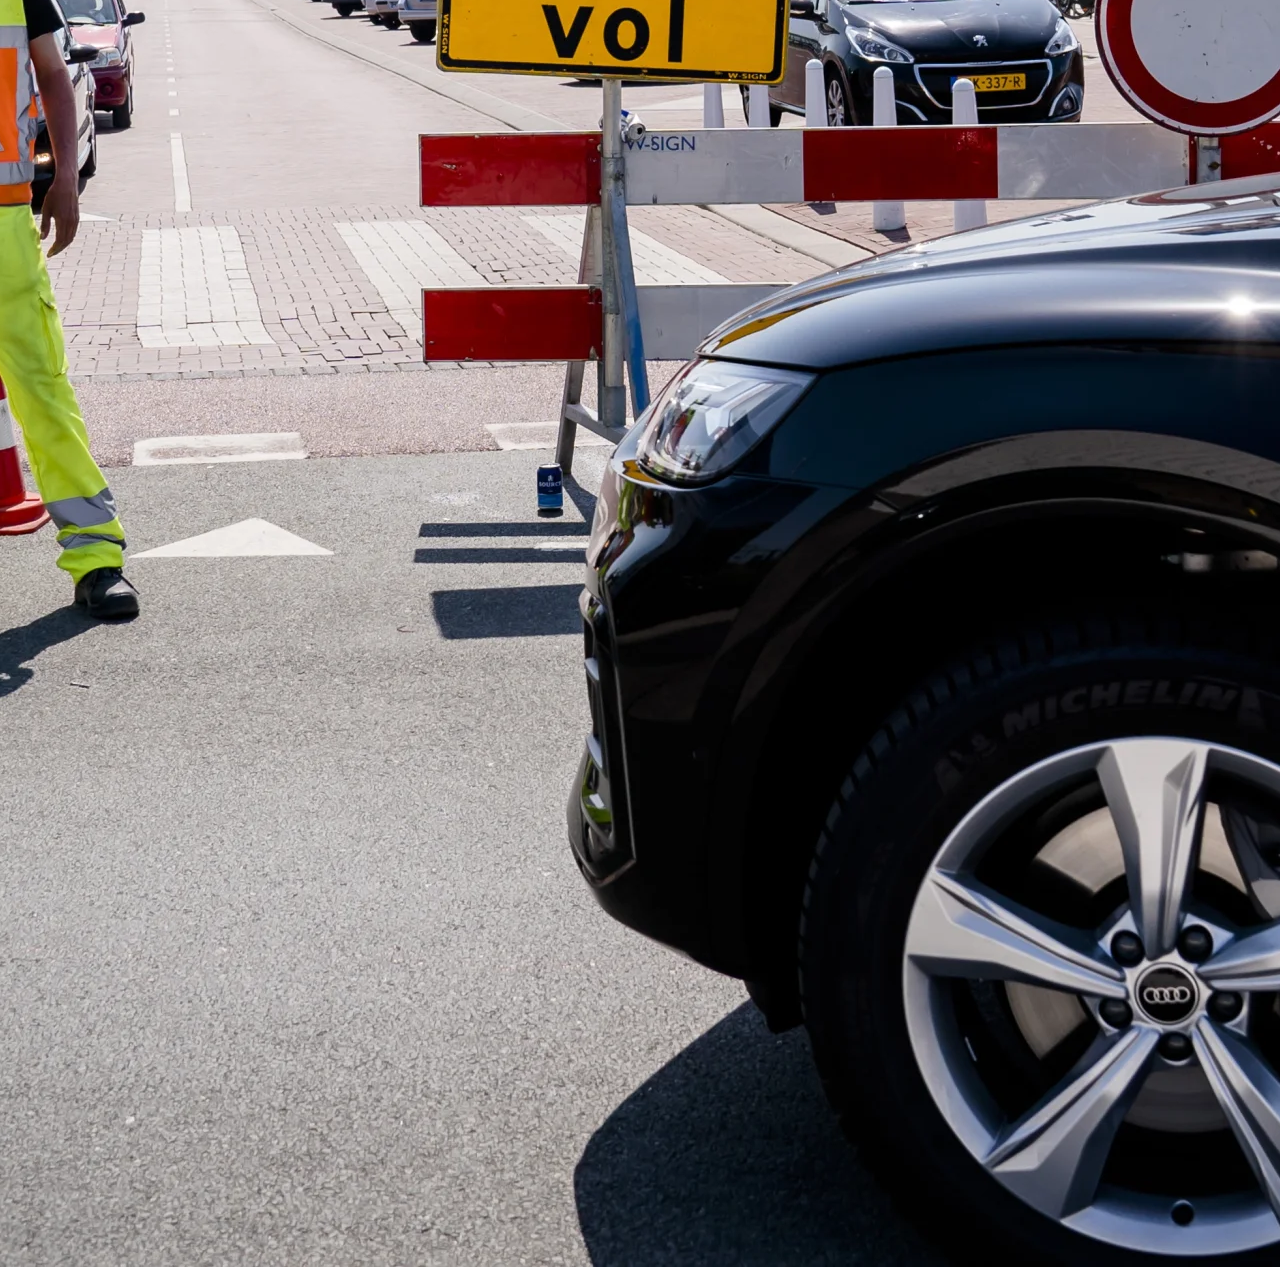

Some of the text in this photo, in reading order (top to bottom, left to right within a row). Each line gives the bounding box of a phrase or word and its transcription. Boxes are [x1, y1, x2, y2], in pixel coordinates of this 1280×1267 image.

[441, 13, 449, 54] W-SIGN
[727, 72, 767, 80] W-SIGN
[966, 76, 1021, 90] K-337-R
[1002, 679, 1240, 740] MICHELIN
